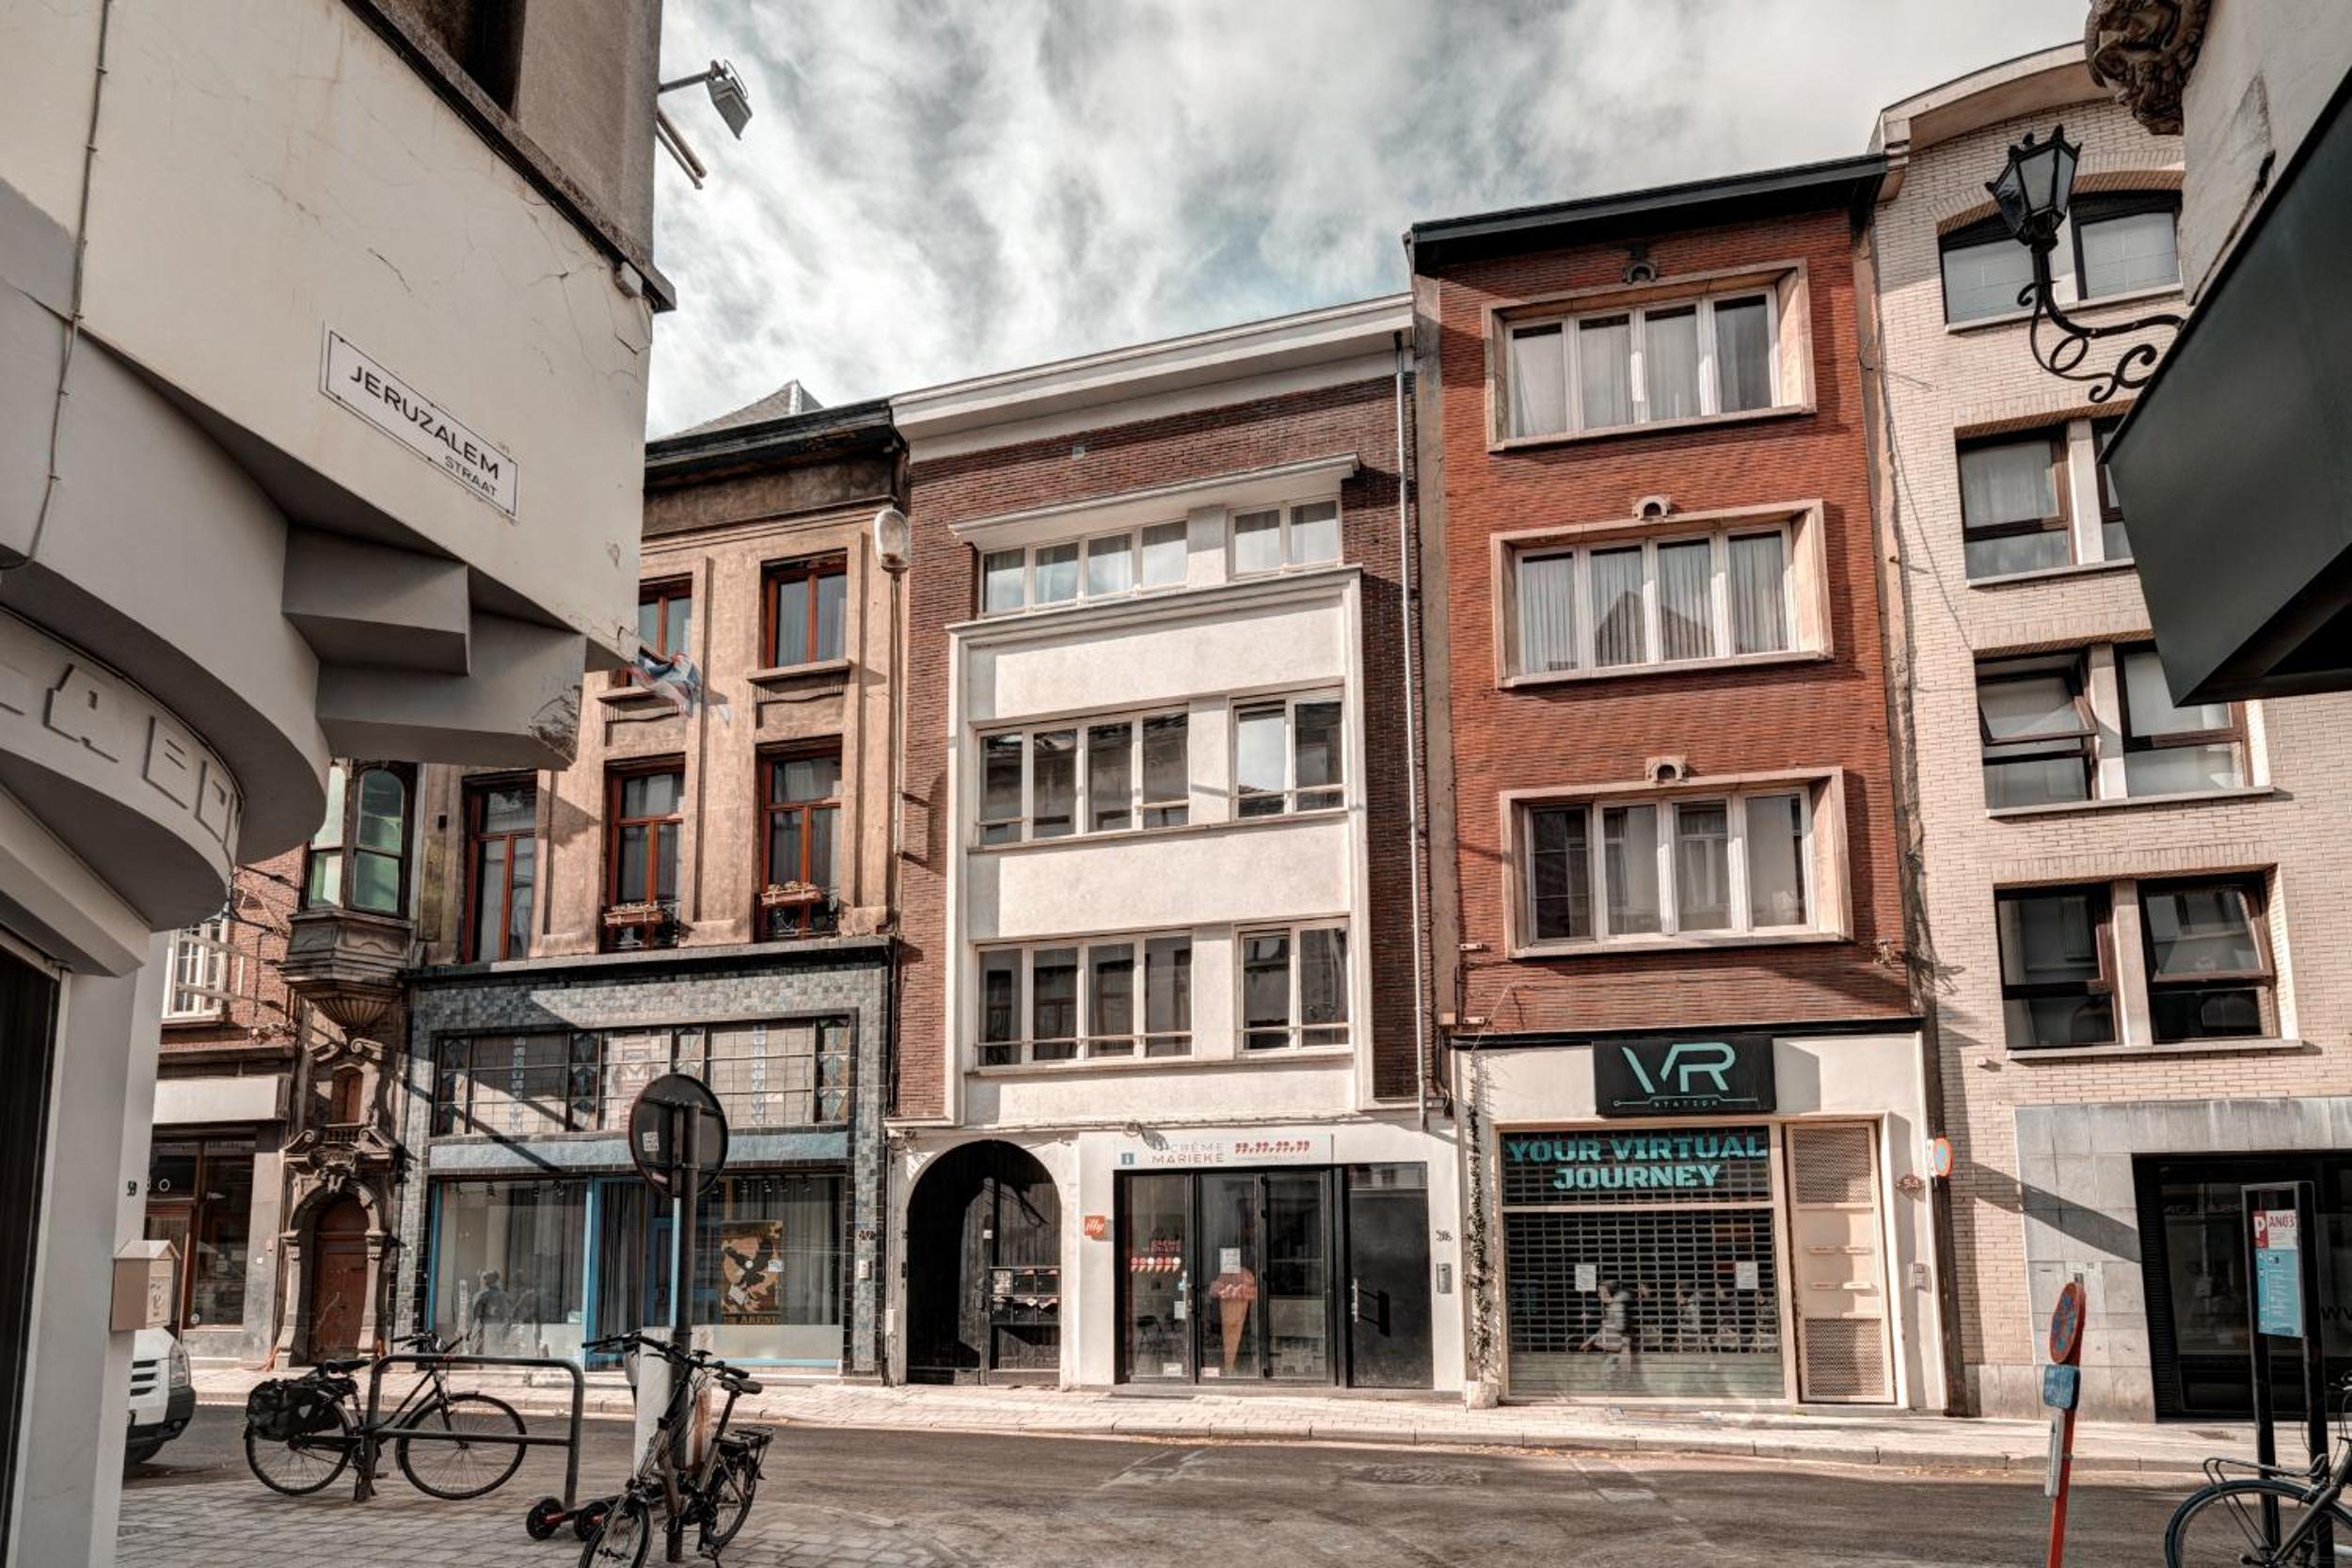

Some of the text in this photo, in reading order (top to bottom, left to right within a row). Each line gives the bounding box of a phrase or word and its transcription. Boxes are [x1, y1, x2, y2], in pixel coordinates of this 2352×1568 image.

[350, 366, 501, 480] JERUZALEM
[444, 456, 498, 496] STRAAT
[1621, 1042, 1737, 1094] VR
[1152, 1153, 1224, 1164] MARIEKE
[1507, 1136, 1769, 1163] YOUR VIRTUAL
[1552, 1164, 1722, 1190] JOURNEY
[1086, 1219, 1104, 1234] illy
